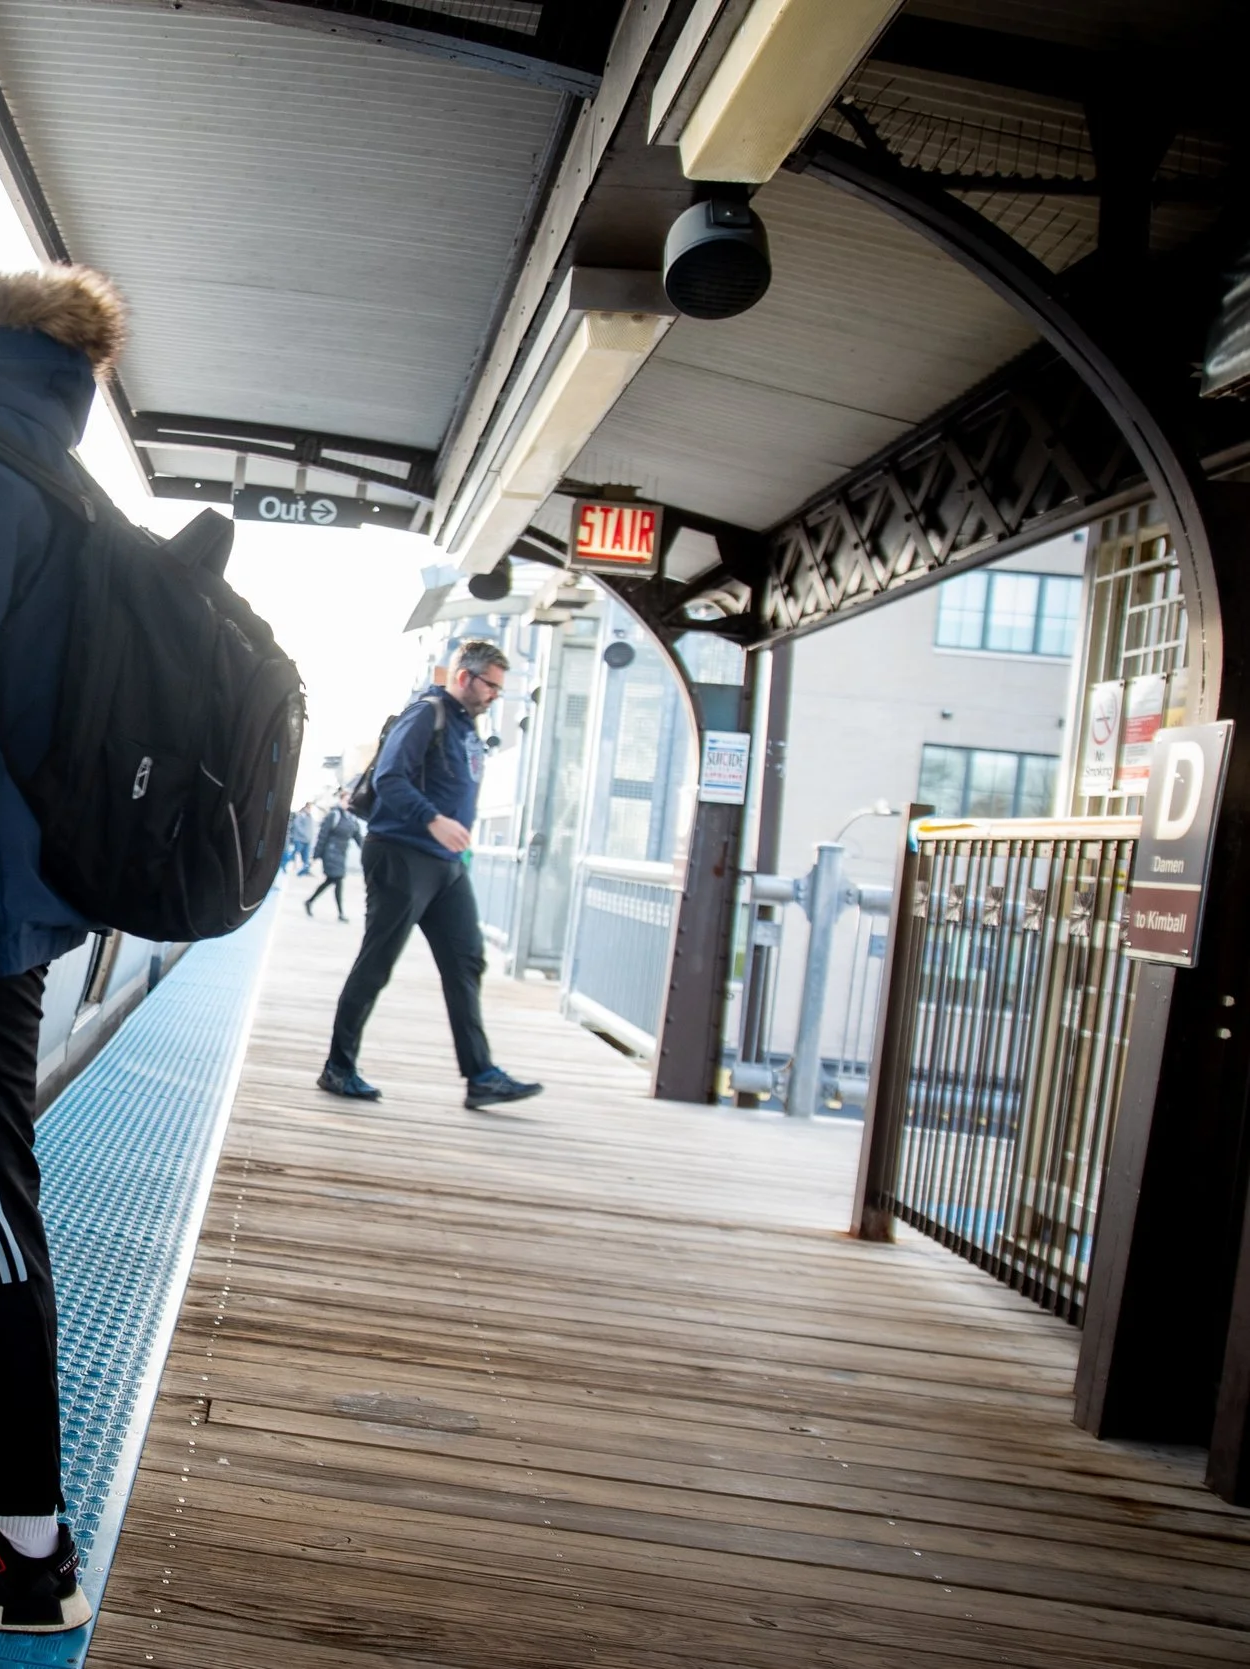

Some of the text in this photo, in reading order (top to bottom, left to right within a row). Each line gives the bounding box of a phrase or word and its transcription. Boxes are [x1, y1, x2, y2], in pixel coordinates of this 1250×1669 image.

[258, 496, 306, 521] Out
[577, 506, 655, 553] STAIR
[707, 752, 743, 768] SUICIDE
[1094, 750, 1105, 761] No
[1085, 766, 1113, 781] Smoking
[1153, 741, 1205, 840] D
[1153, 856, 1184, 874] Damen
[1136, 910, 1187, 934] to Kimball
